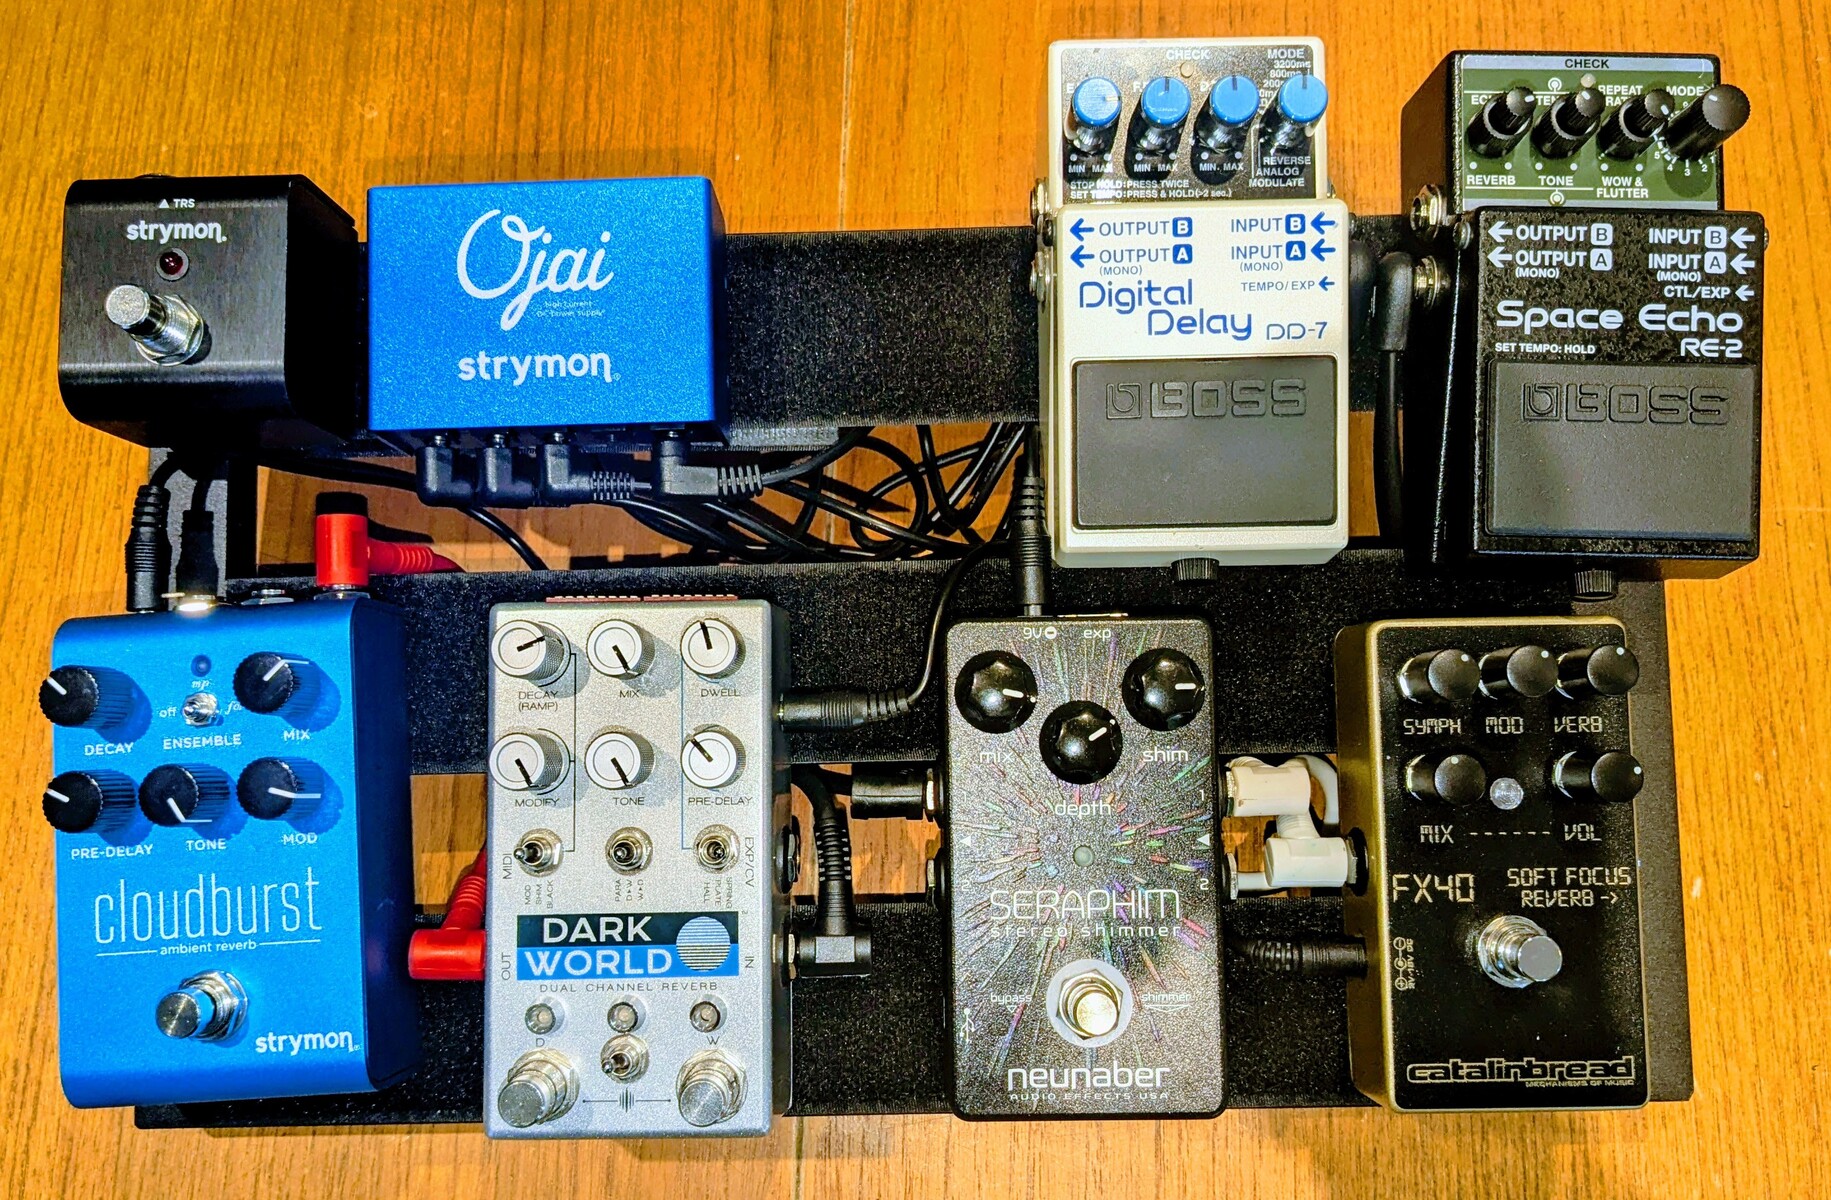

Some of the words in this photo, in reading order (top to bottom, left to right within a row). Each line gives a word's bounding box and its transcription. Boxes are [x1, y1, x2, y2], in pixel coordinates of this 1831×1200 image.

[1166, 49, 1210, 60] CHECK
[1267, 49, 1305, 59] MODE
[1273, 60, 1312, 68] 3200ms
[1564, 59, 1610, 69] CHECK
[1598, 85, 1643, 96] REPEAT
[1666, 86, 1704, 96] MODE
[1262, 156, 1311, 165] REVERSE
[1654, 151, 1660, 159] 5
[1068, 164, 1085, 173] MIN
[1092, 163, 1113, 173] MAX
[1157, 163, 1178, 172] MAX
[1223, 162, 1244, 171] MAX
[1256, 167, 1300, 176] ANALOG
[1667, 163, 1673, 171] 4
[1684, 168, 1690, 176] 3
[1702, 164, 1707, 172] 2
[1070, 181, 1095, 189] STOP
[1161, 179, 1190, 188] TWICE
[1248, 177, 1305, 187] MODULATE
[1466, 175, 1516, 186] REVERB
[1538, 176, 1574, 186] TONE
[1601, 176, 1632, 187] WOW
[1634, 177, 1643, 187] &
[1070, 190, 1088, 199] SET
[1596, 187, 1649, 199] FLUTTER
[173, 198, 195, 208] TRS
[1099, 220, 1170, 237] OUTPUT
[1230, 217, 1282, 233] INPUT
[1515, 224, 1588, 241] OUTPUT
[1648, 228, 1702, 244] INPUT
[1099, 248, 1170, 264] OUTPUT
[1230, 245, 1283, 260] INPUT
[1515, 250, 1588, 267] OUTPUT
[1239, 261, 1283, 272] (MONO)
[1648, 253, 1701, 270] INPUT
[457, 209, 615, 331] Ojai
[1099, 265, 1143, 276] (MONO)
[1515, 267, 1560, 279] (MONO)
[1656, 270, 1701, 283] (MONO)
[1079, 279, 1193, 315] Digital
[1663, 285, 1731, 299] CTL/EXP
[1148, 308, 1252, 341] Delay
[1496, 300, 1624, 335] Space
[1638, 303, 1743, 333] Echo
[1266, 322, 1328, 341] DD-7
[1494, 342, 1517, 353] SET
[1518, 343, 1562, 354] TEMPO:
[1564, 344, 1596, 355] HOLD
[1680, 338, 1743, 359] RE-2
[458, 350, 612, 386] strymon
[1150, 378, 1306, 419] BOSS
[1565, 384, 1731, 425] BOSS
[1083, 628, 1112, 641] exp
[518, 690, 559, 700] DECAY
[619, 689, 641, 699] MIX
[700, 688, 741, 698] DWELL
[159, 706, 177, 718] off
[517, 701, 559, 712] (RAMP)
[1403, 718, 1462, 735] SYMPH
[1485, 716, 1524, 734] MOD
[1553, 716, 1603, 733] VERB
[163, 733, 242, 750] ENSEMBLE
[283, 729, 311, 742] MIX
[84, 742, 135, 756] DECAY
[1142, 747, 1189, 762] shim
[979, 751, 1014, 763] mix
[514, 798, 560, 807] MODIFY
[612, 797, 645, 806] TONE
[688, 796, 753, 806] PRE-DELAY
[1055, 800, 1112, 819] depth
[283, 832, 318, 845] MOD
[1419, 824, 1454, 843] MIX
[1564, 823, 1602, 842] VOL
[71, 843, 154, 860] PRE-DELAY
[185, 838, 227, 852] TONE
[502, 853, 513, 880] MIDI
[744, 836, 755, 888] EXP/CV
[1507, 867, 1558, 887] SOFT
[1565, 866, 1632, 886] FOCUS
[614, 878, 622, 902] PARA
[961, 879, 971, 891] 2
[1200, 878, 1209, 890] 2
[1391, 873, 1475, 903] FX40
[524, 884, 532, 905] MOD
[546, 879, 554, 909] BLACK
[714, 879, 722, 906] PLATE
[1521, 889, 1595, 908] REVERB
[94, 866, 322, 944] cloudburst
[990, 889, 1181, 919] SERAPHIM
[542, 916, 652, 944] DARK
[990, 925, 1068, 938] stereo
[1081, 923, 1182, 938] shimmer
[160, 942, 213, 956] ambient
[215, 939, 257, 952] reverb
[501, 953, 512, 981] OUT
[524, 949, 673, 977] WORLD
[744, 955, 755, 969] IN
[539, 983, 577, 994] DUAL
[586, 982, 653, 993] CHANNEL
[661, 981, 718, 992] REVERB
[990, 992, 1033, 1004] bypass
[1141, 992, 1191, 1002] shimmer
[255, 1030, 355, 1057] strymon
[535, 1037, 545, 1048] D
[706, 1036, 720, 1046] W
[1007, 1060, 1170, 1091] neunaber
[1406, 1055, 1636, 1083] catalinbread
[1009, 1092, 1056, 1101] AUDIO
[1064, 1092, 1131, 1100] EFFECTS
[1139, 1092, 1169, 1100] USA
